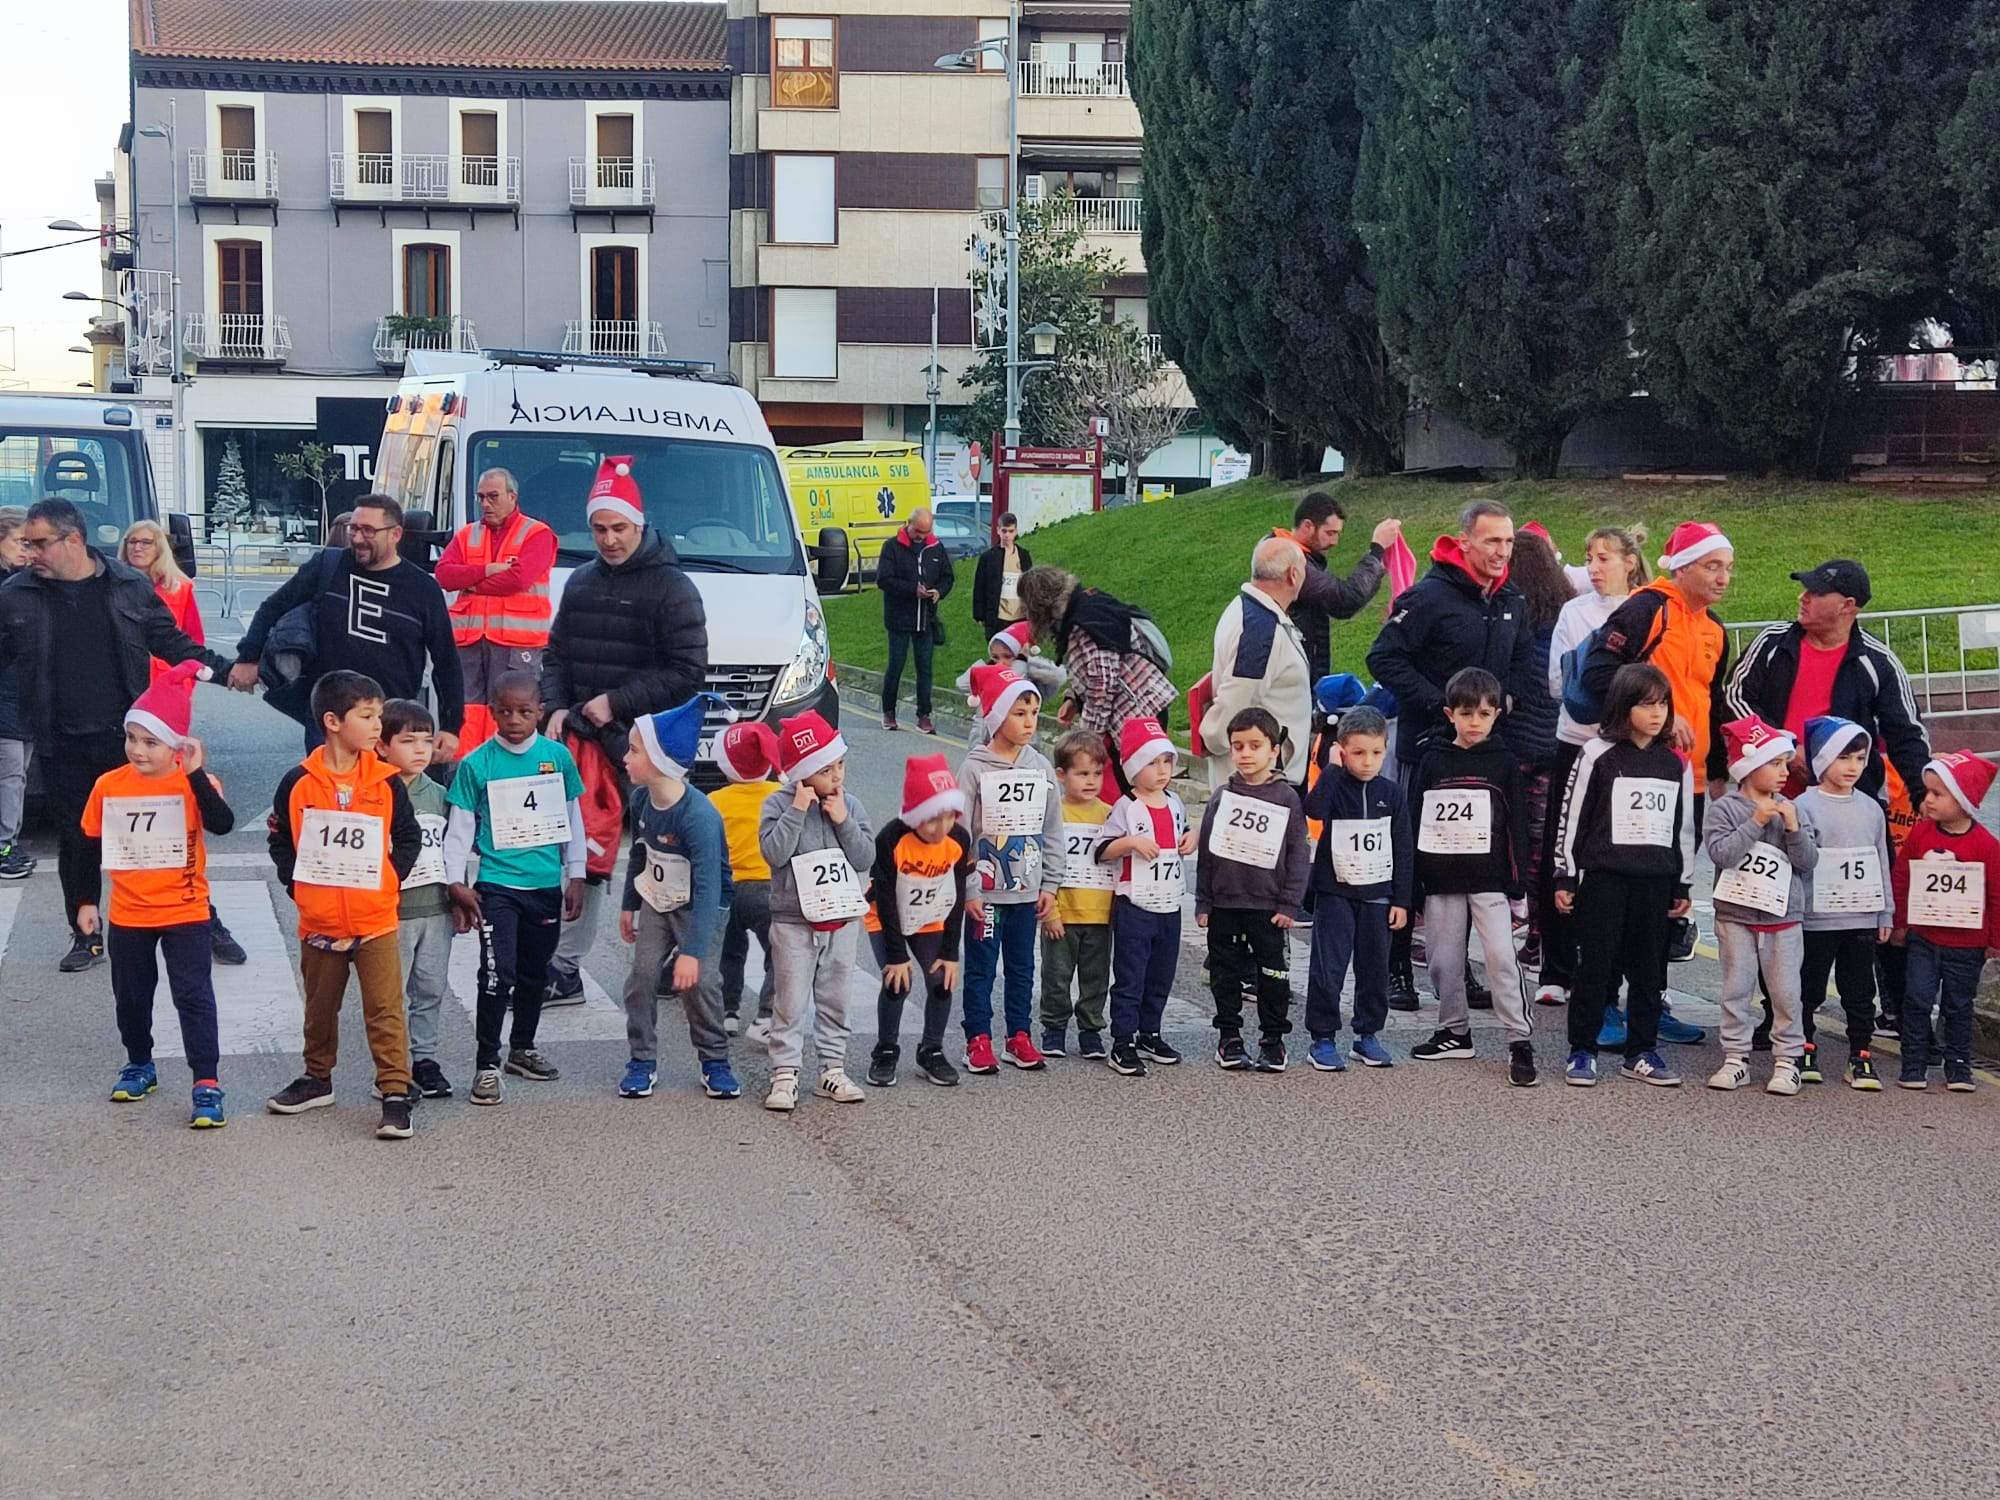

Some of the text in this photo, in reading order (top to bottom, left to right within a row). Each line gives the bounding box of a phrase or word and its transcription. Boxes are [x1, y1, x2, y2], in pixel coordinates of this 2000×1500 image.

[806, 464, 910, 479] AMBULANCIA SVB
[809, 488, 832, 507] 061
[347, 573, 390, 644] E
[523, 790, 538, 811] 4
[998, 782, 1035, 802] 257
[1630, 791, 1666, 812] 230
[126, 811, 157, 832] 77
[1229, 808, 1270, 834] 258
[1435, 802, 1474, 822] 224
[320, 825, 365, 850] 148
[1349, 832, 1382, 852] 167
[813, 862, 849, 886] 251
[1150, 862, 1181, 882] 173
[1739, 852, 1780, 880] 252
[1839, 860, 1865, 880] 15
[1925, 873, 1968, 894] 294
